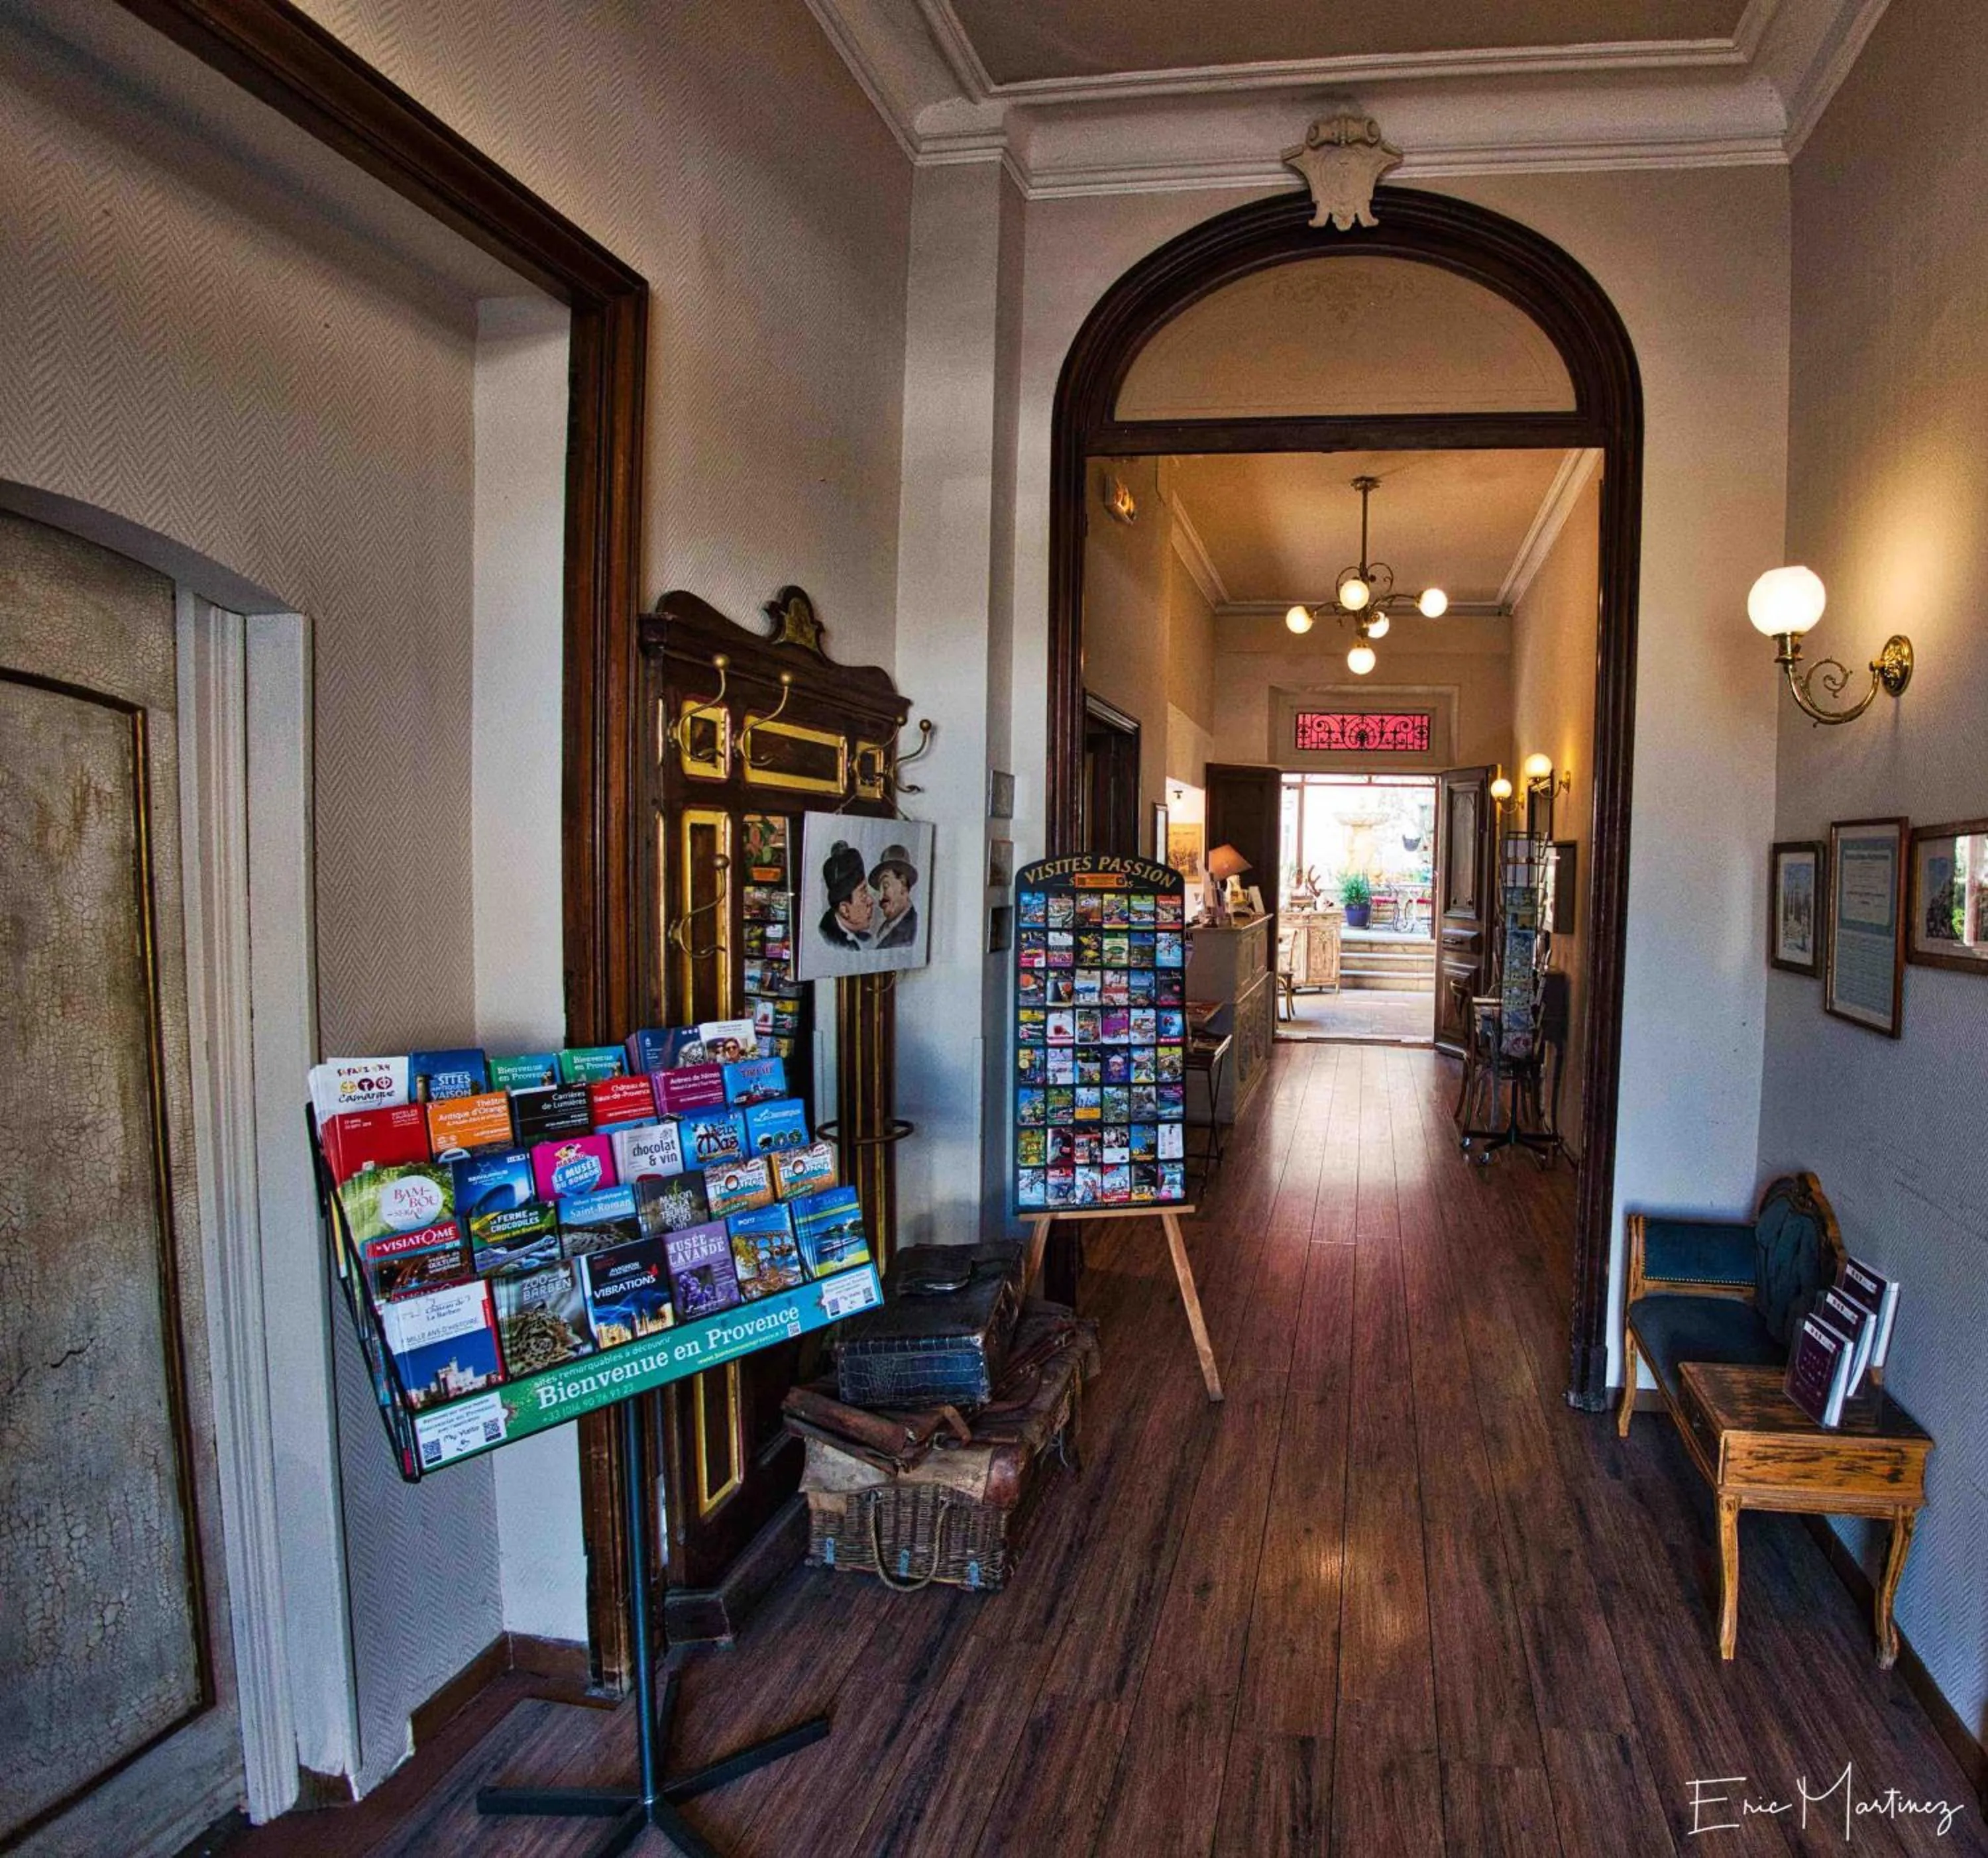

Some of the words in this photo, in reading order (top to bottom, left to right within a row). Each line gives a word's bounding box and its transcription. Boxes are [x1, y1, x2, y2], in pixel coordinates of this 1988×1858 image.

[1024, 855, 1093, 885] VISITES
[1097, 856, 1177, 888] PASSION
[498, 1064, 543, 1075] Bienvenue
[512, 1070, 552, 1081] Provence
[438, 1073, 471, 1086] SITES
[431, 1089, 472, 1100] VAISON
[632, 1140, 676, 1157] chocolat
[649, 1155, 657, 1167] &
[661, 1150, 678, 1164] vin
[571, 1197, 631, 1218] Saint-Roman
[490, 1216, 540, 1233] CROCODILES
[498, 1209, 528, 1224] FERME
[667, 1232, 707, 1253] MUSÉE
[669, 1240, 725, 1265] LAVANDE
[522, 1274, 548, 1291] ZOO
[523, 1277, 572, 1301] BARBEN
[594, 1274, 656, 1299] VIBRATIONS
[535, 1350, 669, 1410] Bienvenue
[674, 1339, 702, 1361] en
[705, 1307, 800, 1350] Provence
[559, 1352, 624, 1380] remarquables
[582, 1397, 595, 1407] 90
